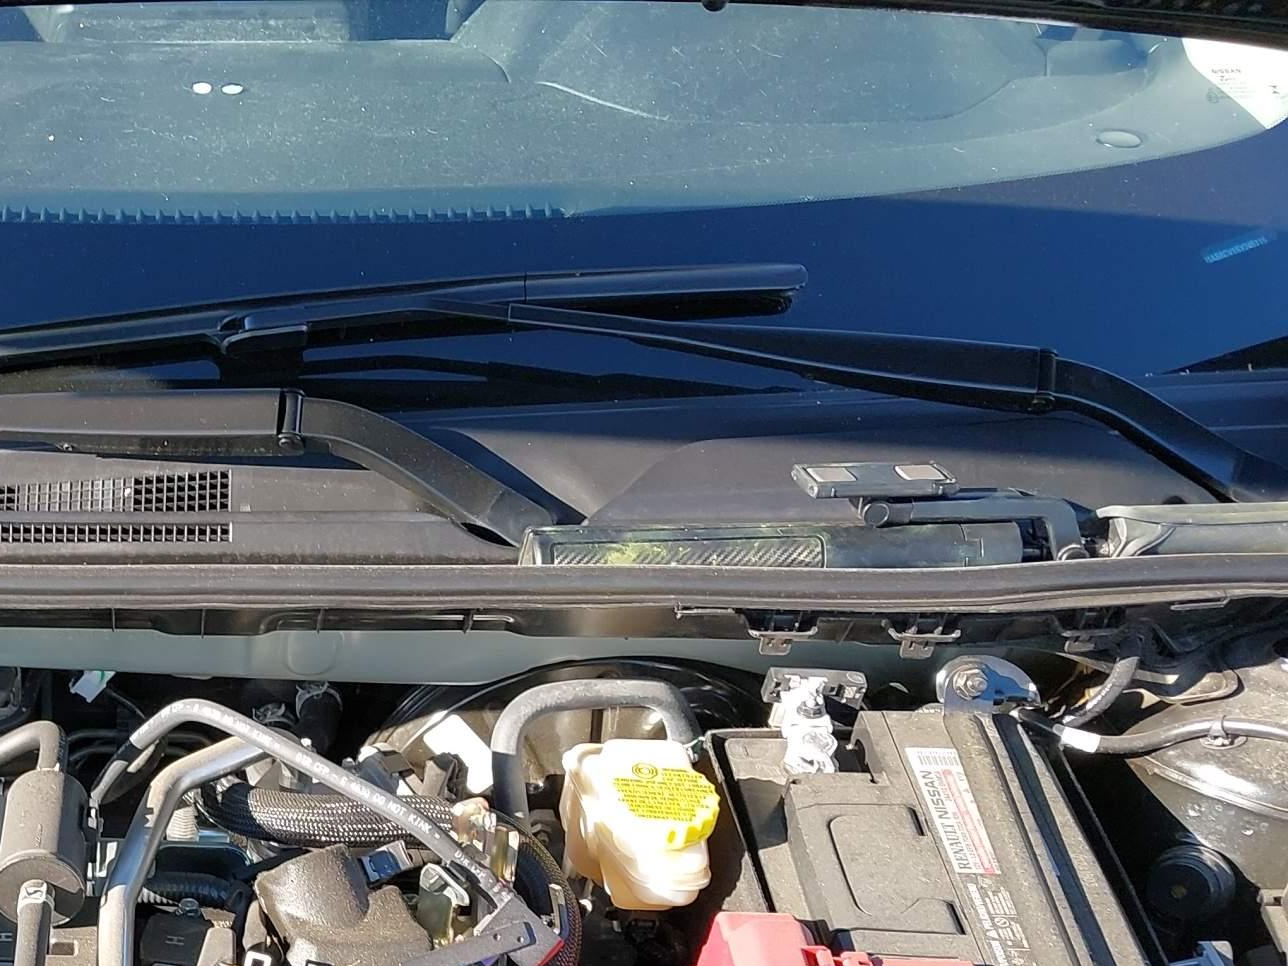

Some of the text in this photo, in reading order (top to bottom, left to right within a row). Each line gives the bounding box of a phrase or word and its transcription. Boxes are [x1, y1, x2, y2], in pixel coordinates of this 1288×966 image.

[387, 801, 408, 816] NOT
[920, 770, 952, 820] NISSAN
[941, 822, 973, 870] RENAULT
